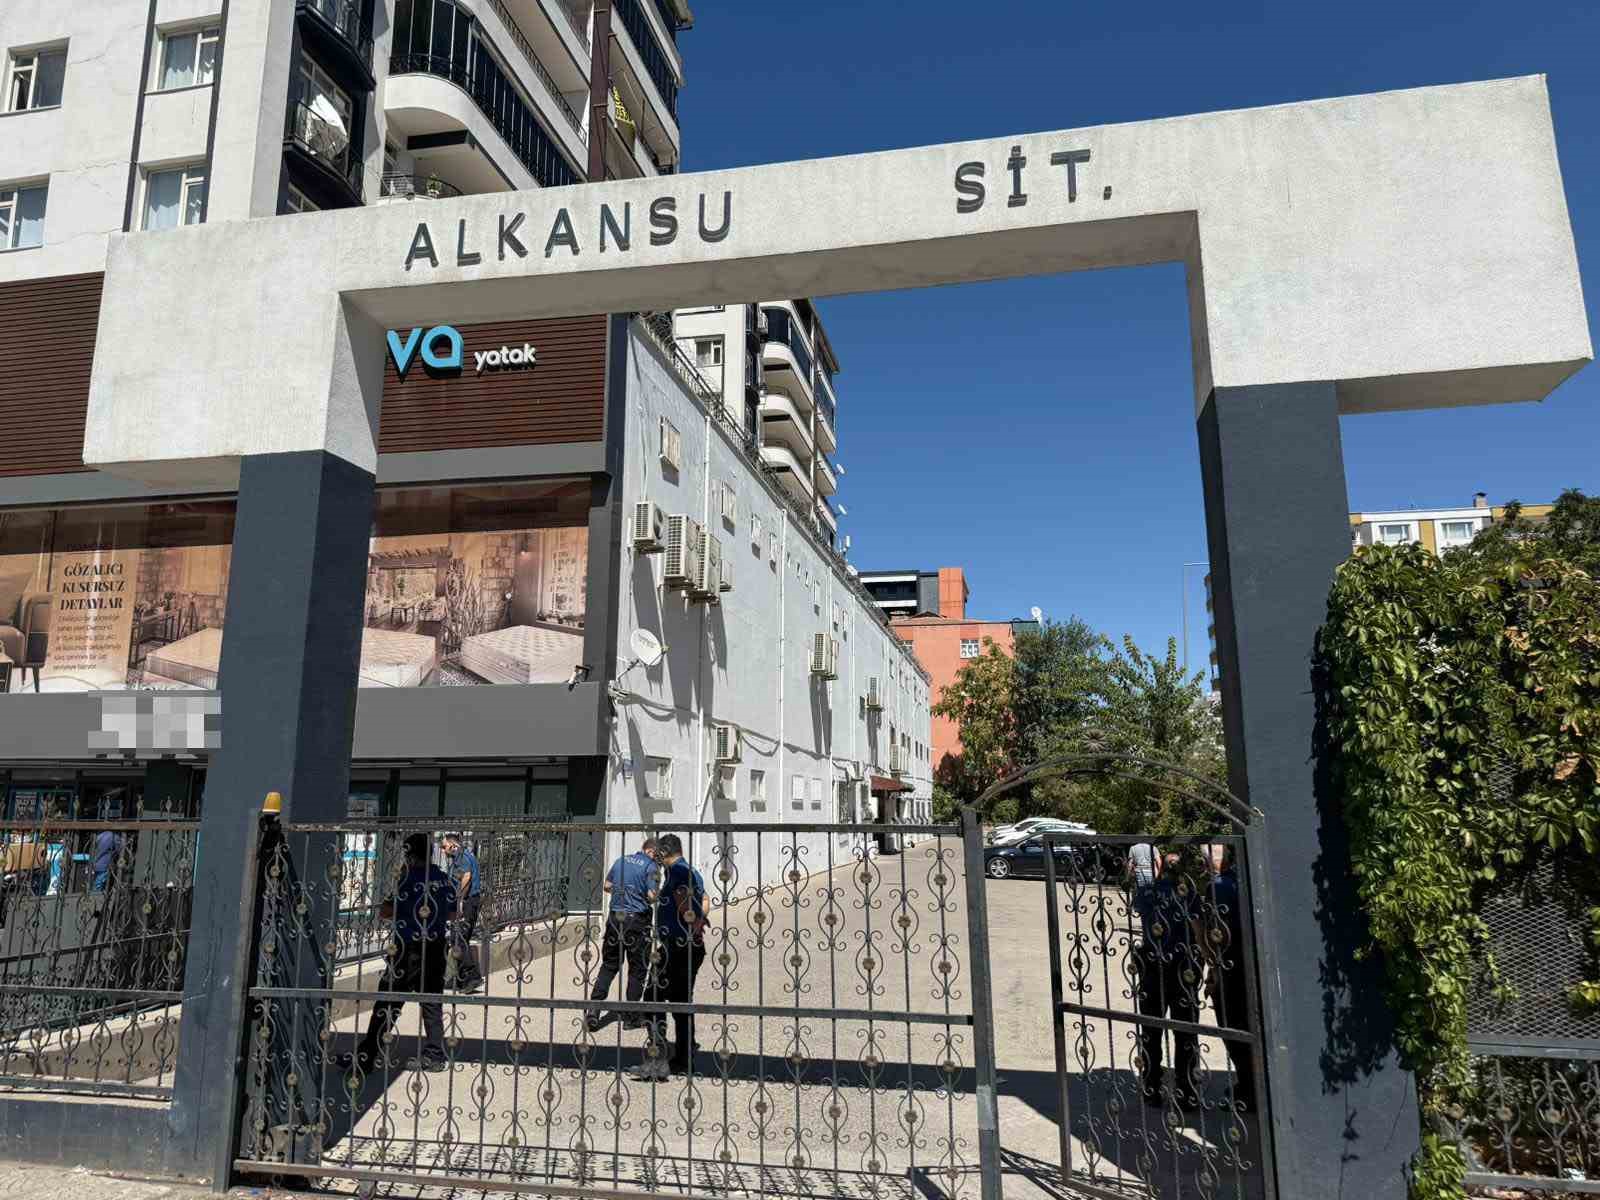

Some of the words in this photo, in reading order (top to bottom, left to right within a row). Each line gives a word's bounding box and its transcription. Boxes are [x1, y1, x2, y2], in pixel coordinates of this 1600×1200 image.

[405, 190, 732, 272] ALKANSU
[955, 145, 1113, 214] SİT.
[473, 343, 537, 373] yatak
[60, 597, 123, 610] DETAYLAR
